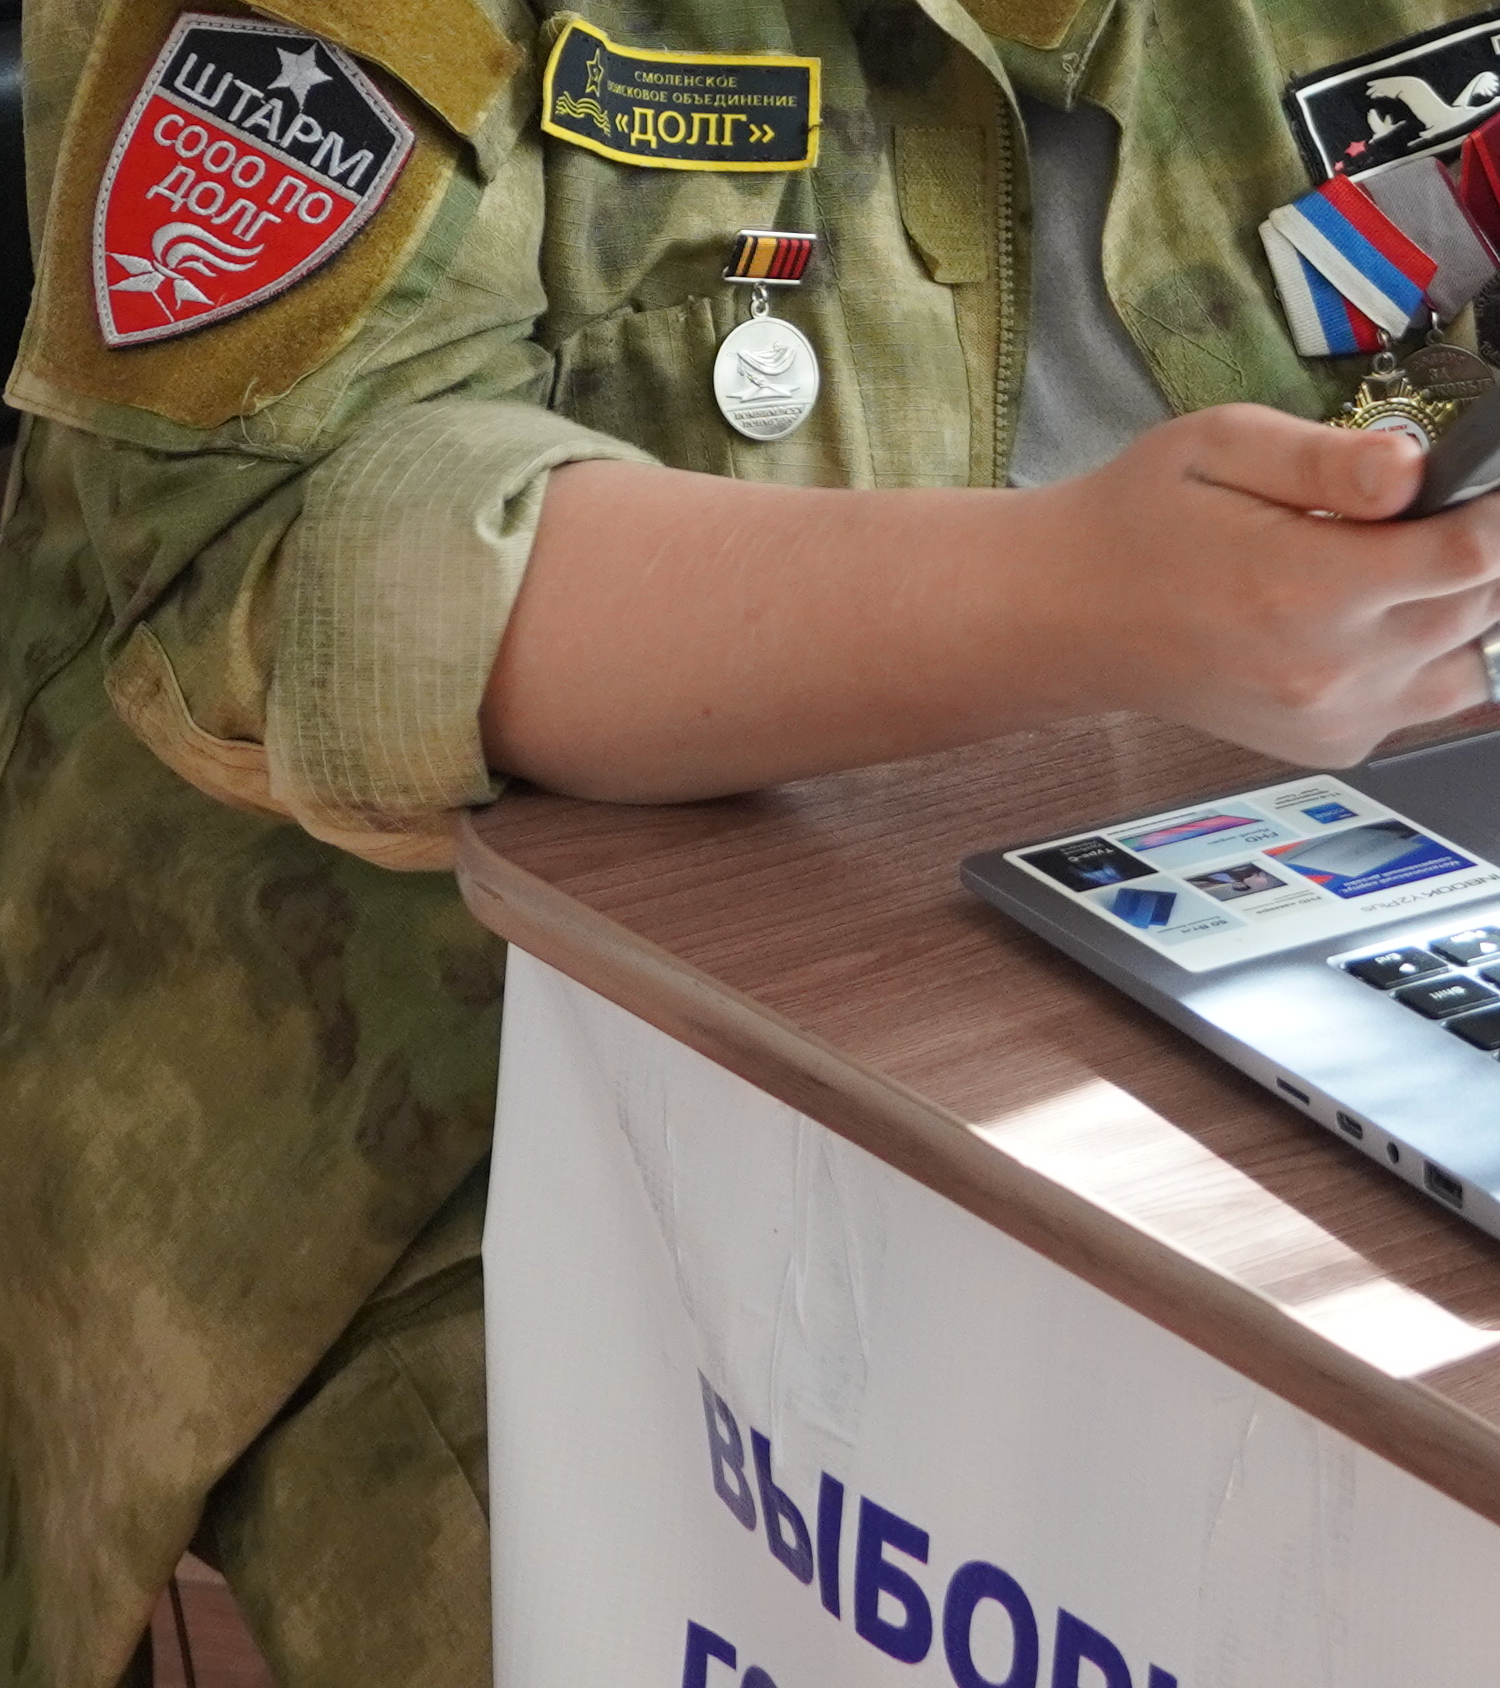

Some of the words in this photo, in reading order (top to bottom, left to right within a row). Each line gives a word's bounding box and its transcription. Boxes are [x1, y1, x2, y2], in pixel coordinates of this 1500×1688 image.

[634, 70, 738, 88] СМОЛЕНСКОЕ
[672, 92, 798, 108] ОБЪЕДИНЕНИЕ
[173, 52, 374, 188] ШТАРМ
[615, 106, 776, 150] «ДОЛГ»
[153, 113, 266, 189] СООО
[267, 174, 334, 224] ПО
[145, 163, 282, 242] ДОЛГ
[1245, 831, 1279, 843] FHD
[1430, 985, 1466, 1000] Shift
[696, 1367, 1178, 1688] ВЫБОР
